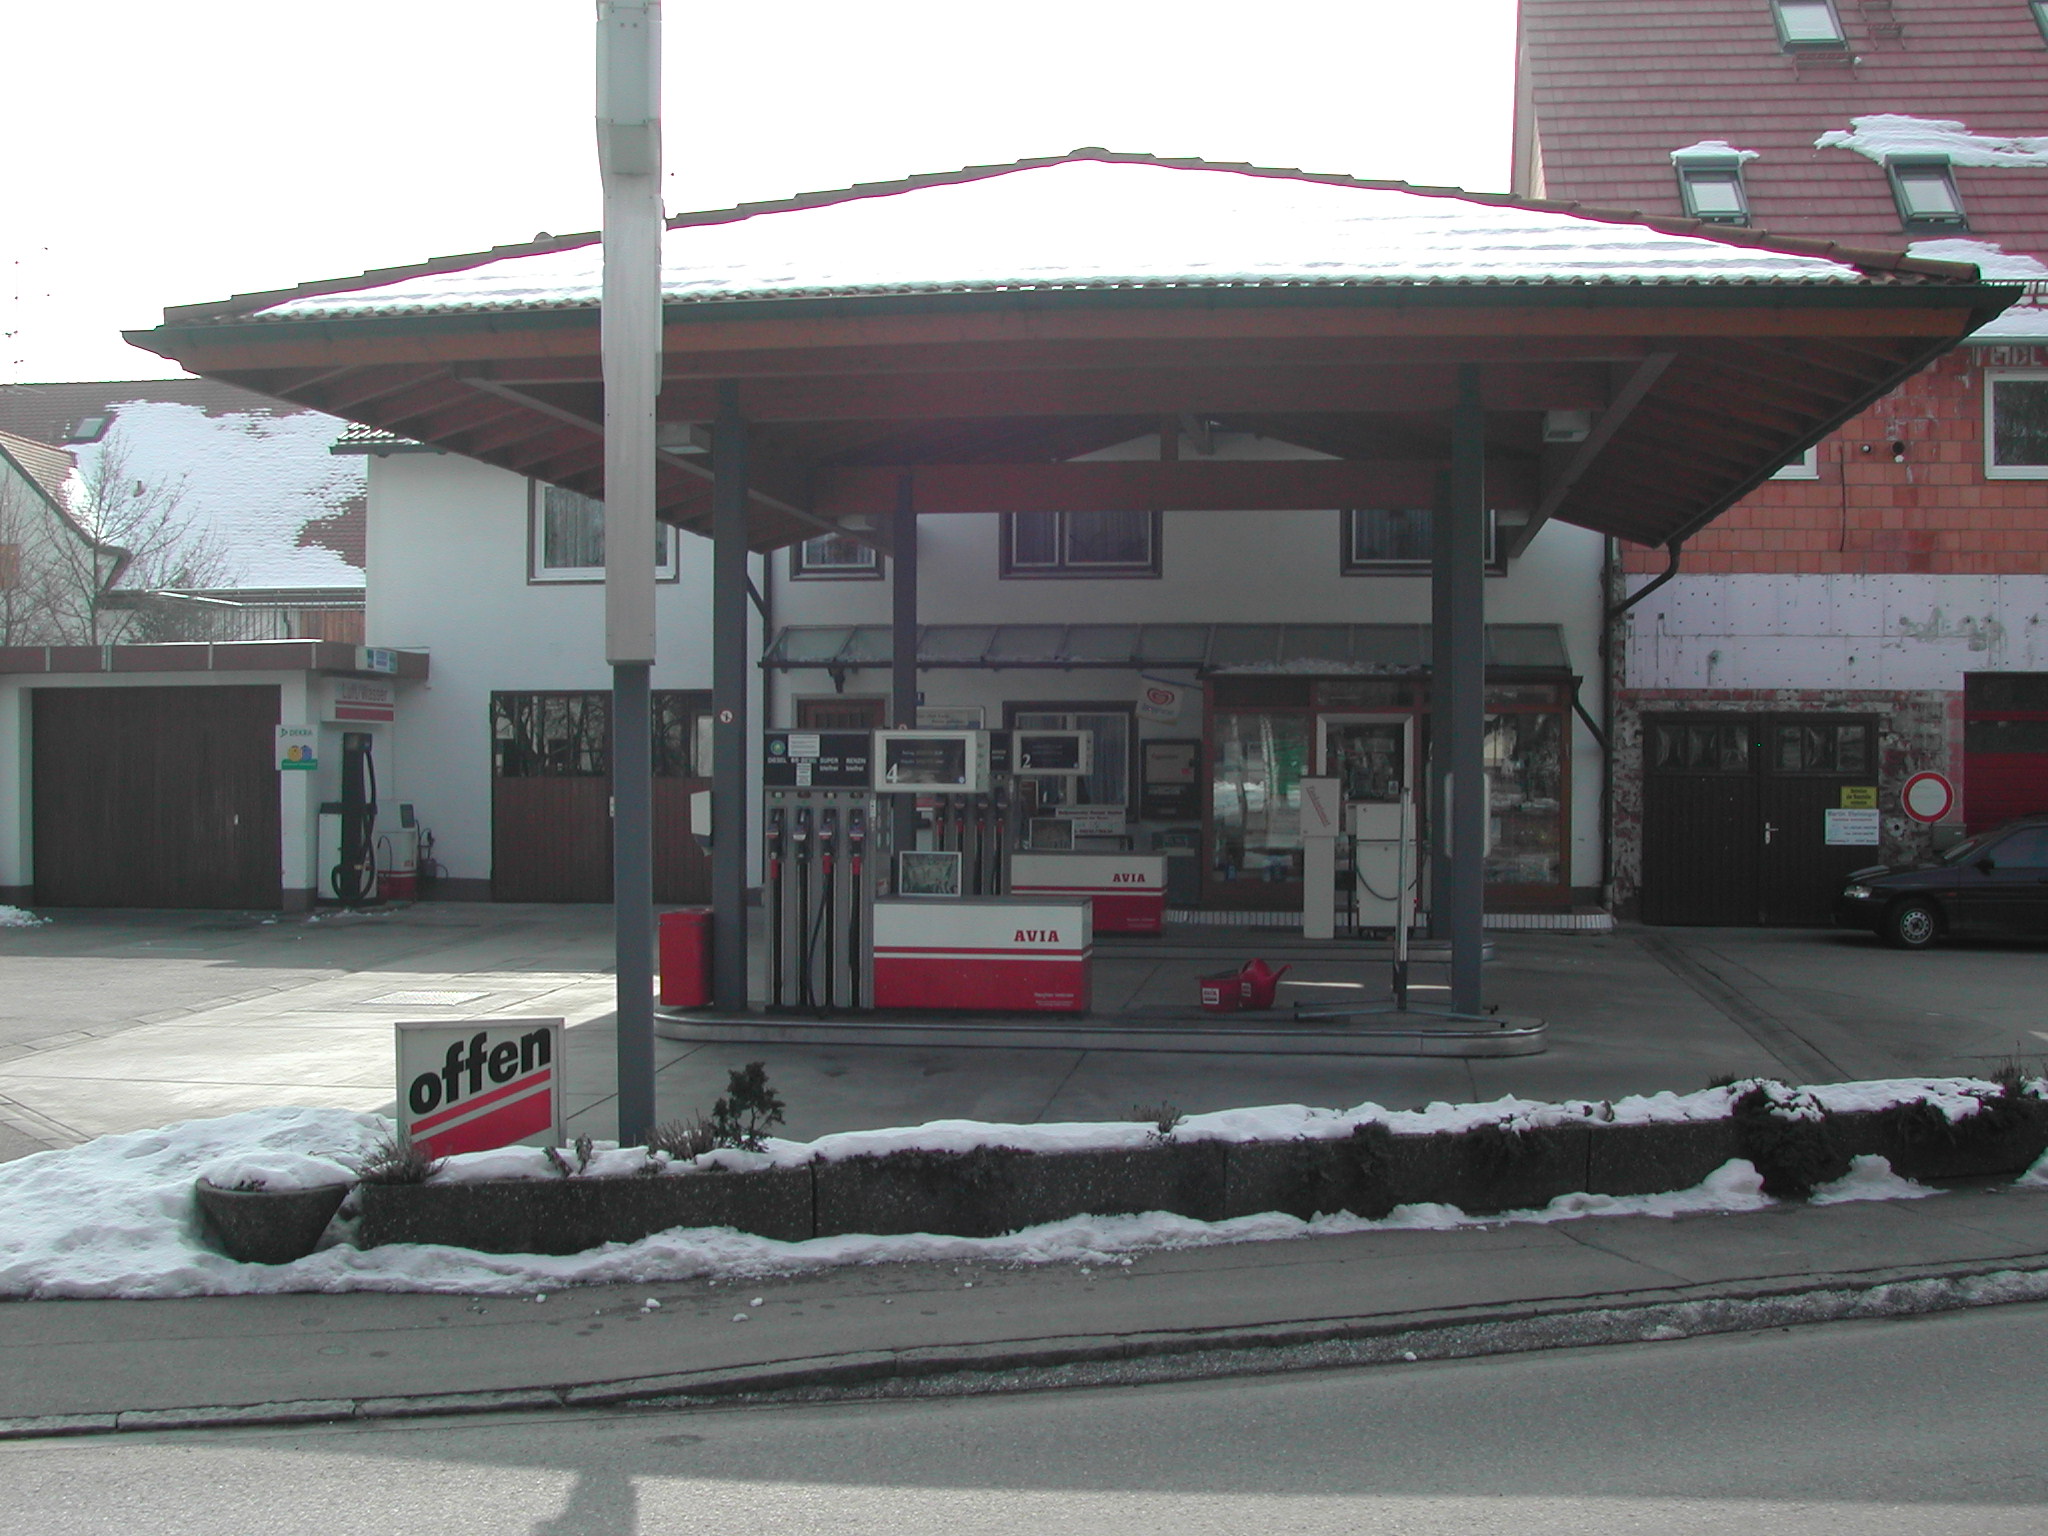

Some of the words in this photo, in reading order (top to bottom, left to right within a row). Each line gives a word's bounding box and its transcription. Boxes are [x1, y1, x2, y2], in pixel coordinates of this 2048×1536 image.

[1022, 753, 1032, 768] 2
[886, 762, 899, 784] 4
[1112, 873, 1147, 883] AVIA
[1014, 929, 1061, 943] AVIA
[409, 1027, 551, 1115] offen
